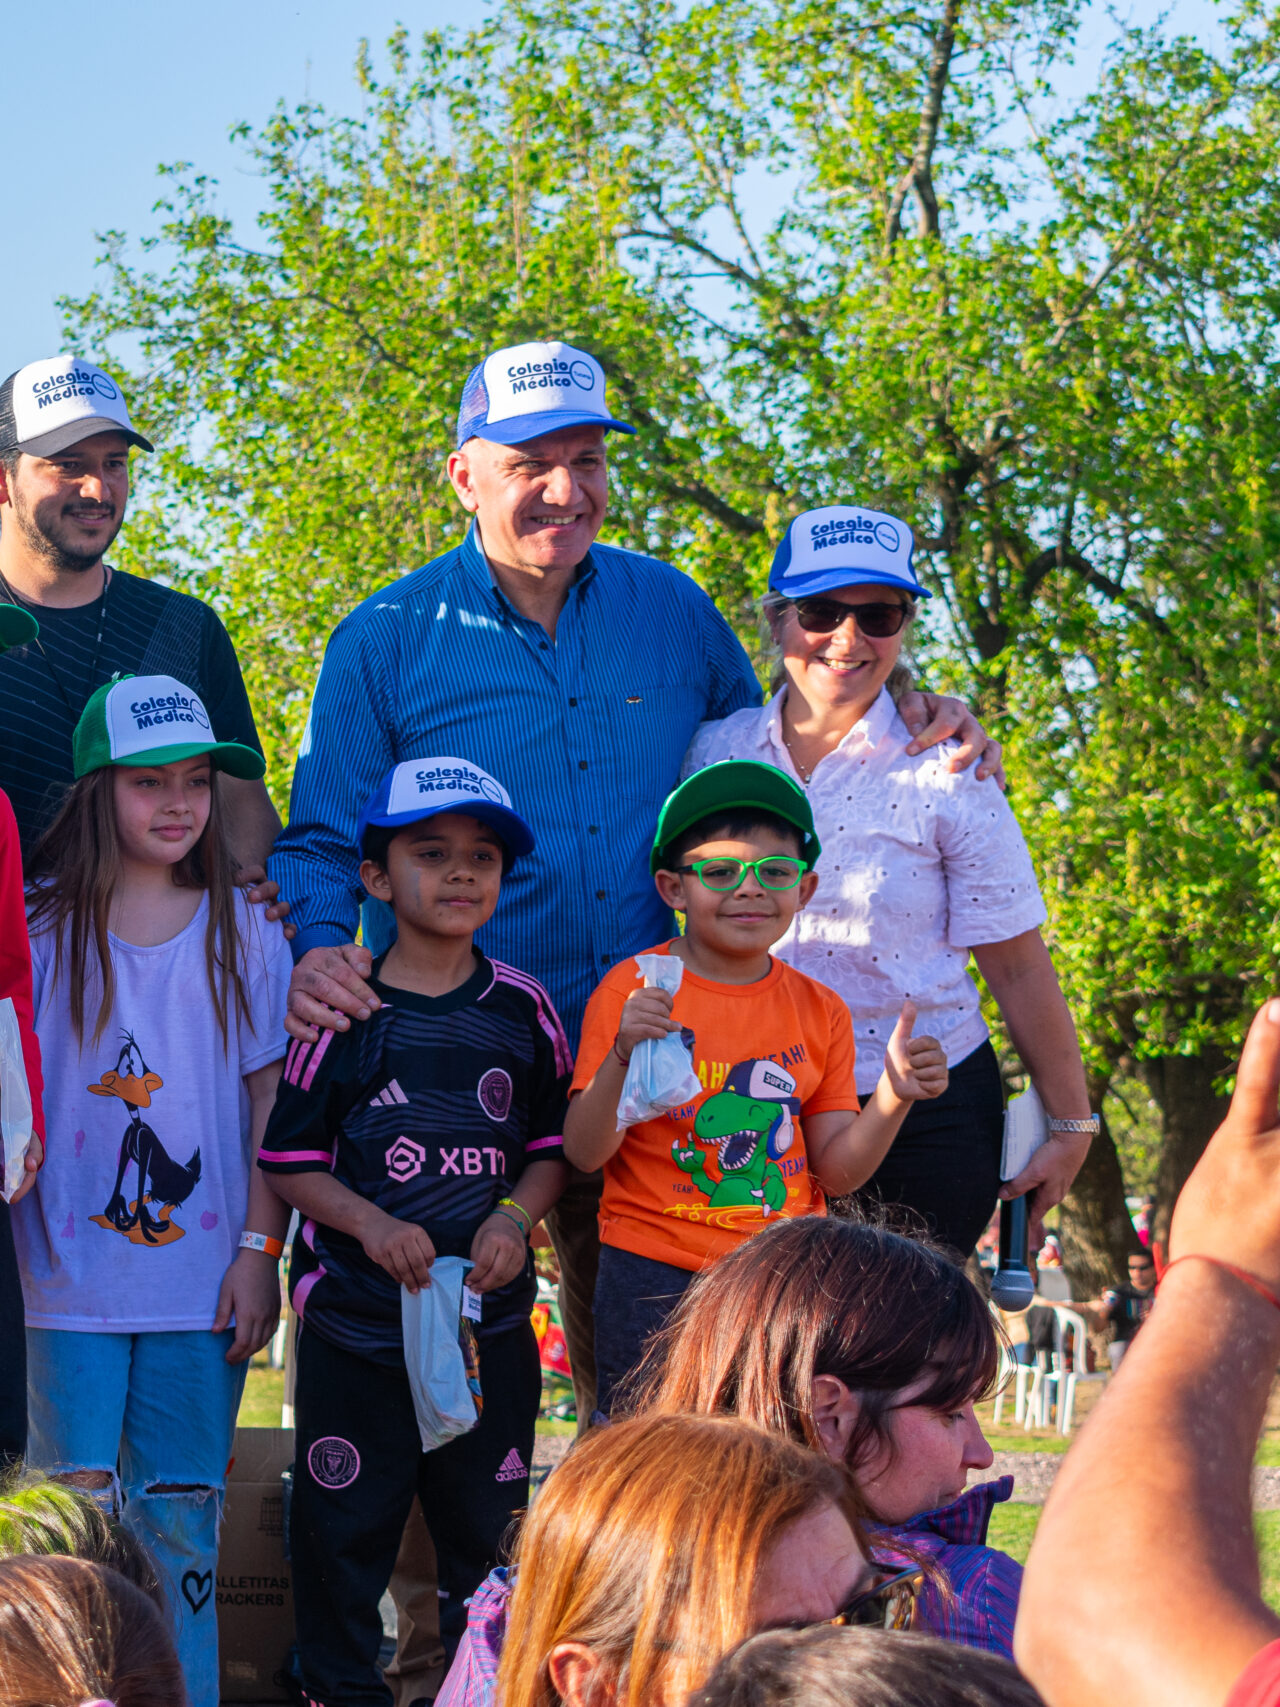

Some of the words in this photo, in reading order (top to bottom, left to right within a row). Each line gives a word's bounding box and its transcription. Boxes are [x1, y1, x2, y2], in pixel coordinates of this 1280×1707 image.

[508, 358, 568, 377] Colegio
[32, 368, 90, 393] Colegio
[512, 374, 571, 394] Médico
[37, 385, 95, 409] Médico
[810, 515, 873, 536] Colegio
[813, 531, 874, 551] Médico
[130, 692, 189, 714] Colegio
[136, 709, 194, 730] Médico
[415, 766, 479, 781] Colegio
[418, 780, 481, 794] Médico
[763, 1072, 792, 1093] SUPER
[215, 1592, 285, 1607] RACKERS
